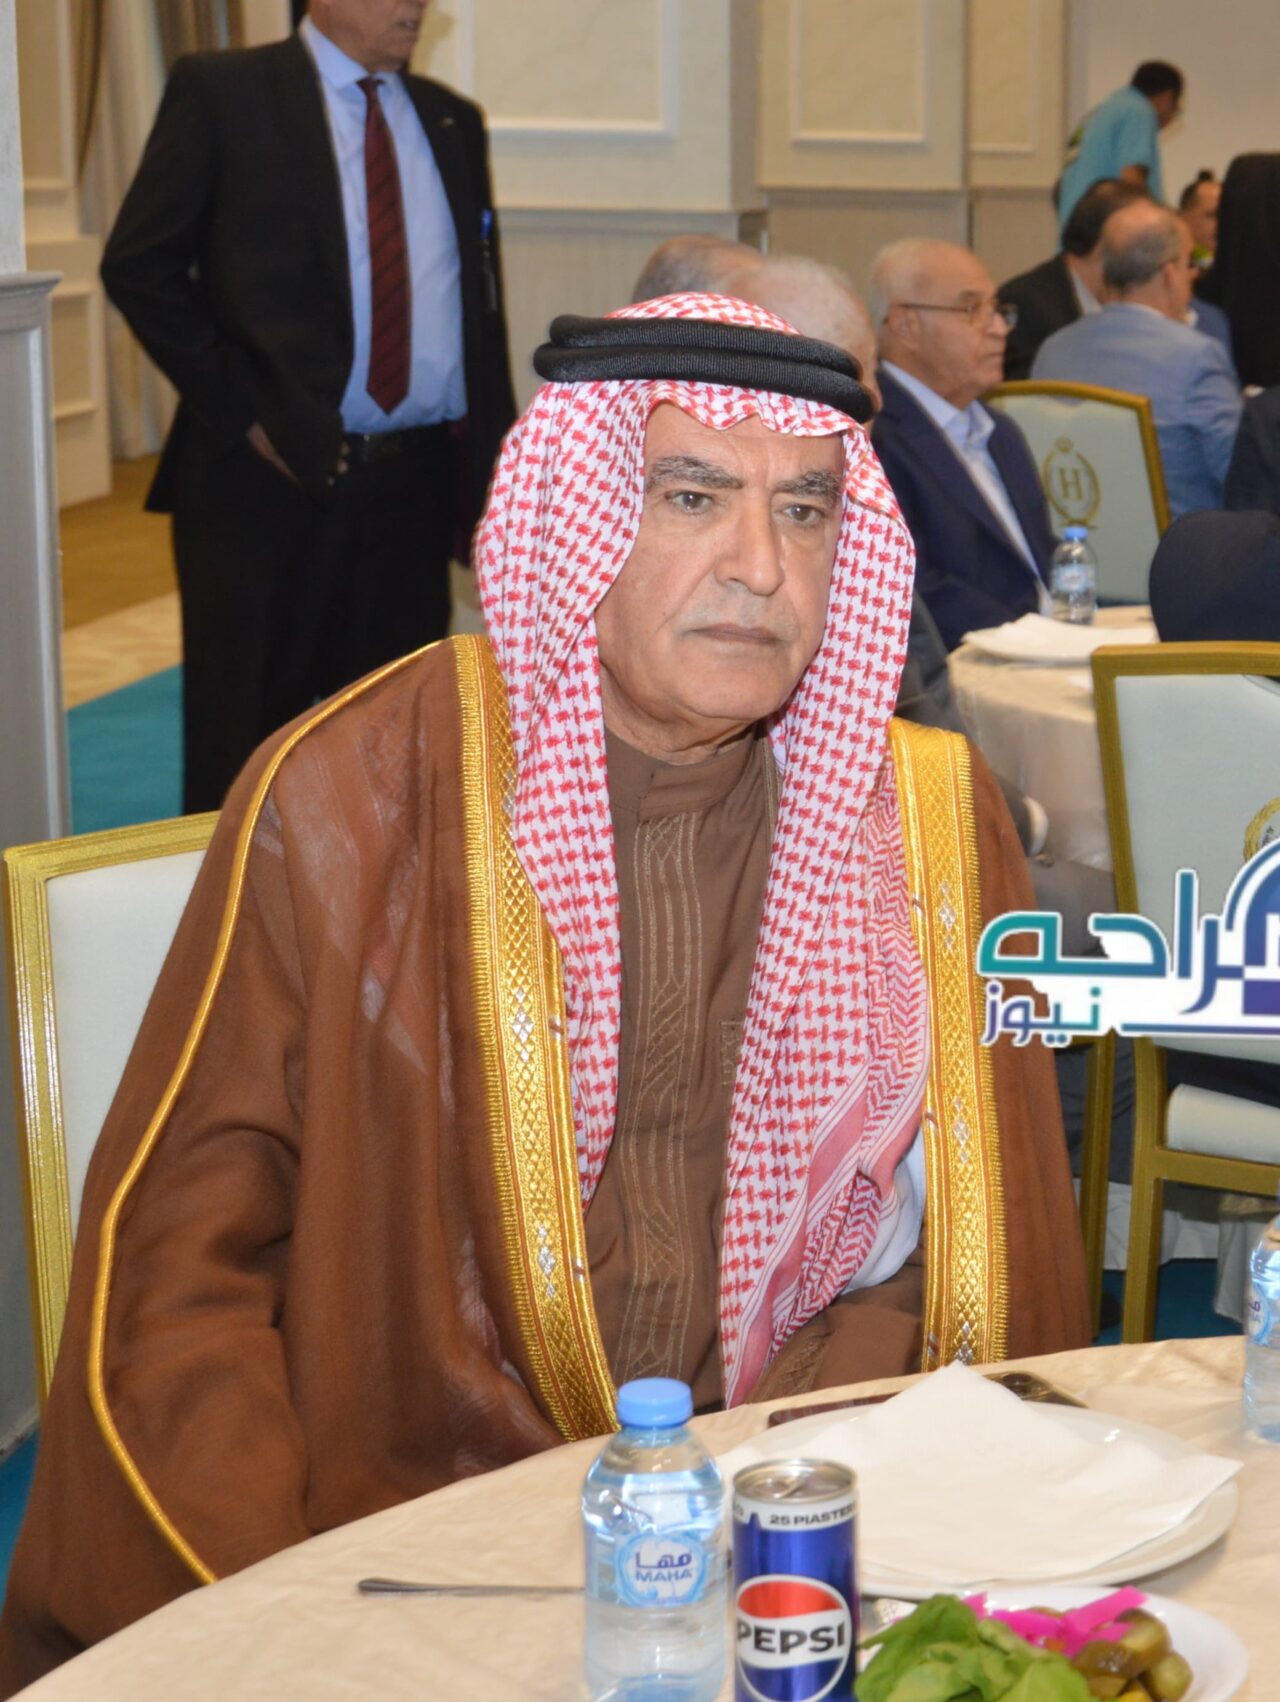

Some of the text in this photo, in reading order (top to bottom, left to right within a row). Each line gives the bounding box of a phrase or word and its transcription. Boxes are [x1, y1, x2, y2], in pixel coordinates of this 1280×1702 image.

[769, 1513, 791, 1526] 25
[636, 1552, 693, 1569] مها
[635, 1568, 693, 1582] MAHA
[737, 1618, 846, 1655] PEPSI
